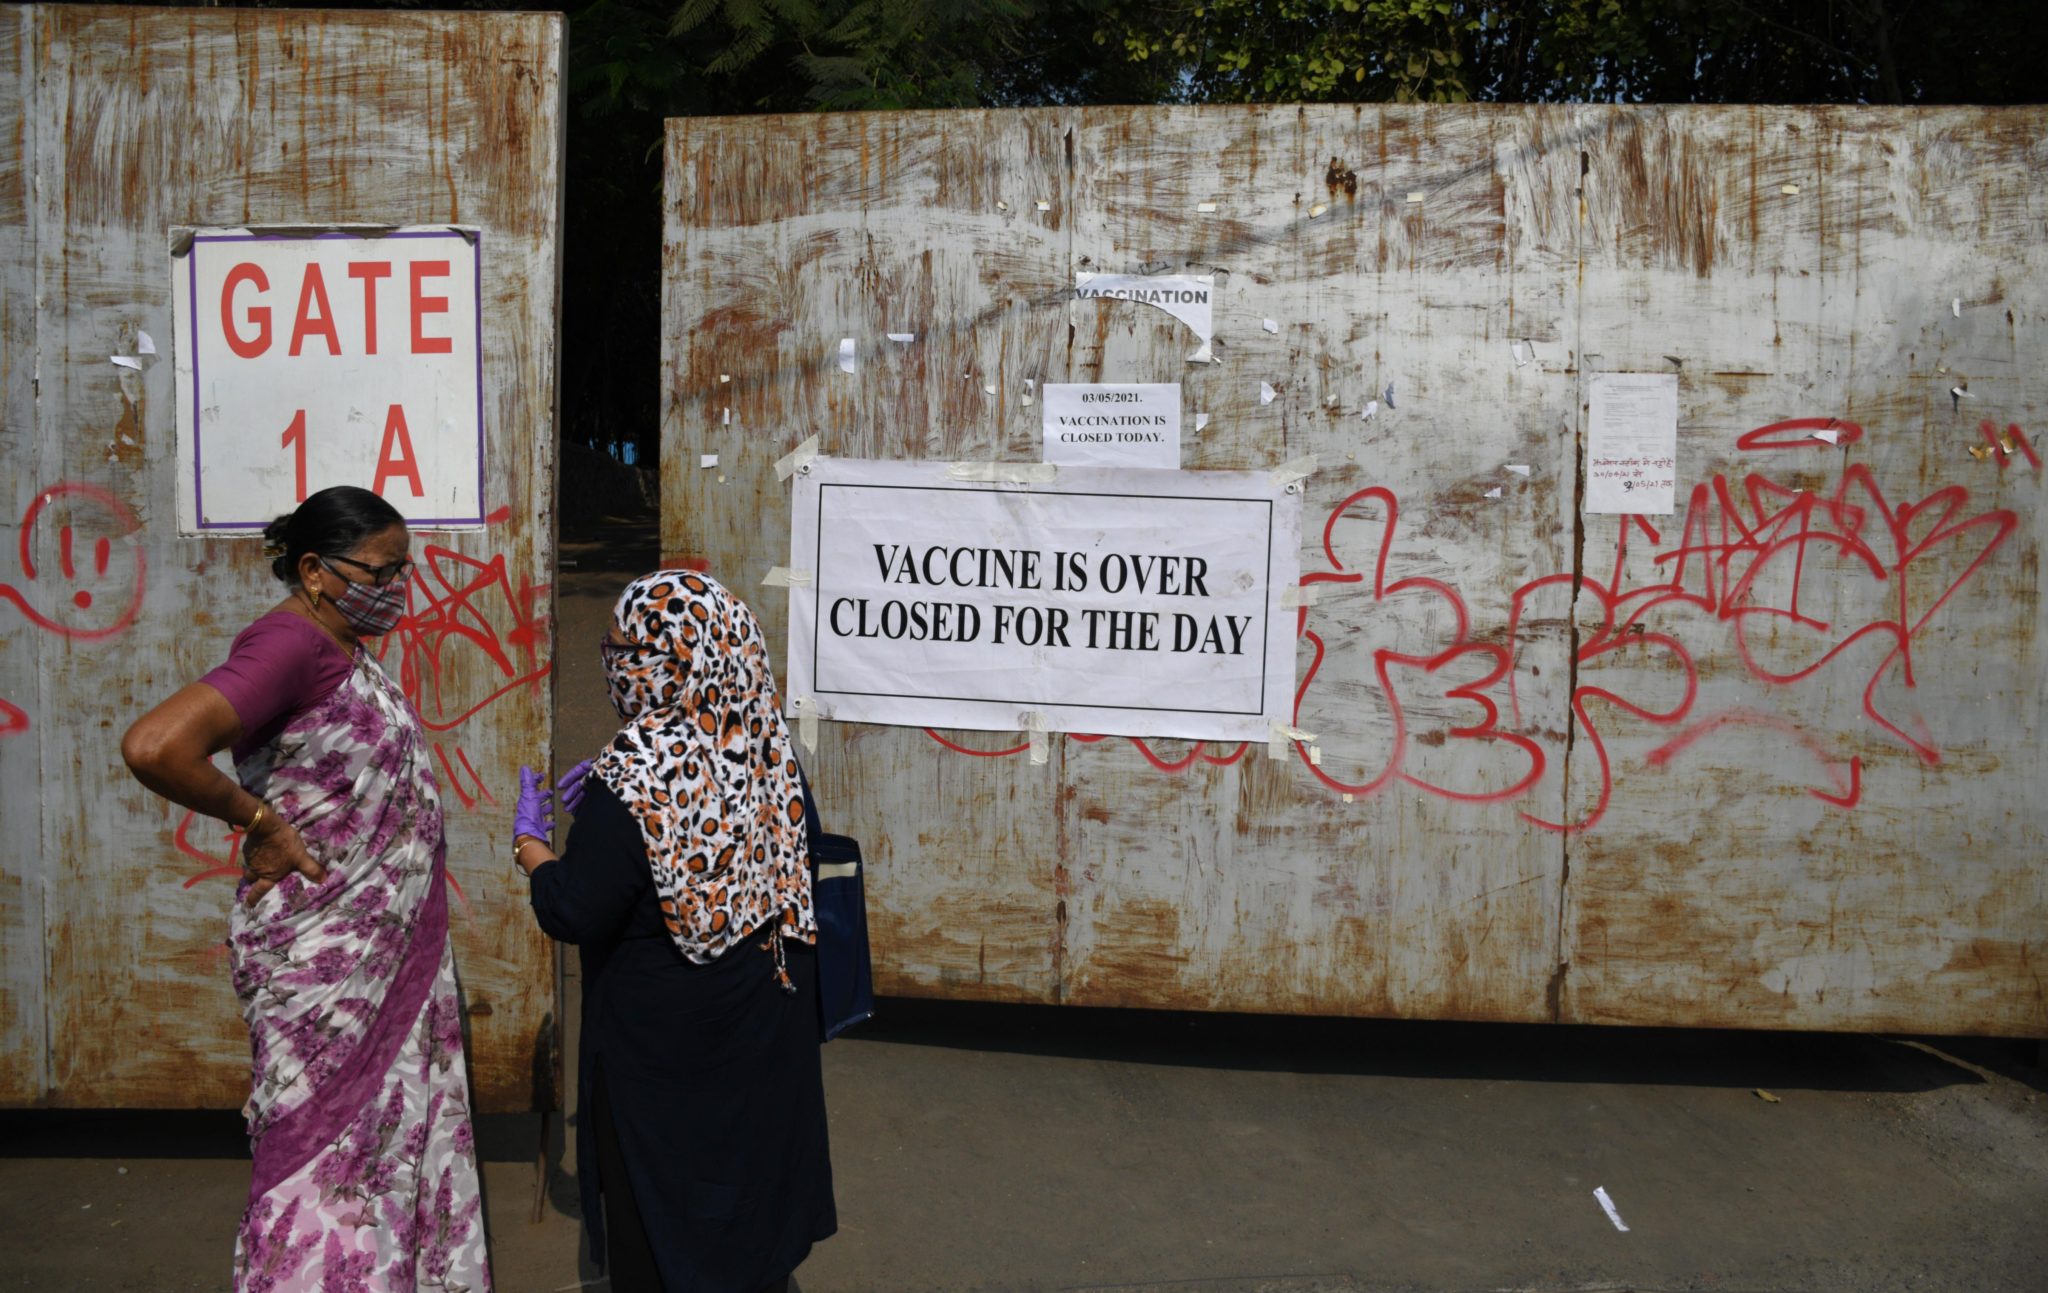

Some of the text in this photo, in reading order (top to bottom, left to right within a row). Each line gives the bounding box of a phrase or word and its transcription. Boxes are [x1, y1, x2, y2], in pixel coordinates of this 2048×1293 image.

[221, 261, 452, 359] GATE
[1060, 415, 1166, 426] VACCINATION IS
[1082, 393, 1143, 403] 03/05/2021.
[281, 404, 424, 503] 1 A
[1061, 432, 1165, 443] CLOSED TODAY.
[873, 543, 1210, 597] VACCINE IS OVER
[829, 598, 1252, 656] CLOSED FOR THE DAY
